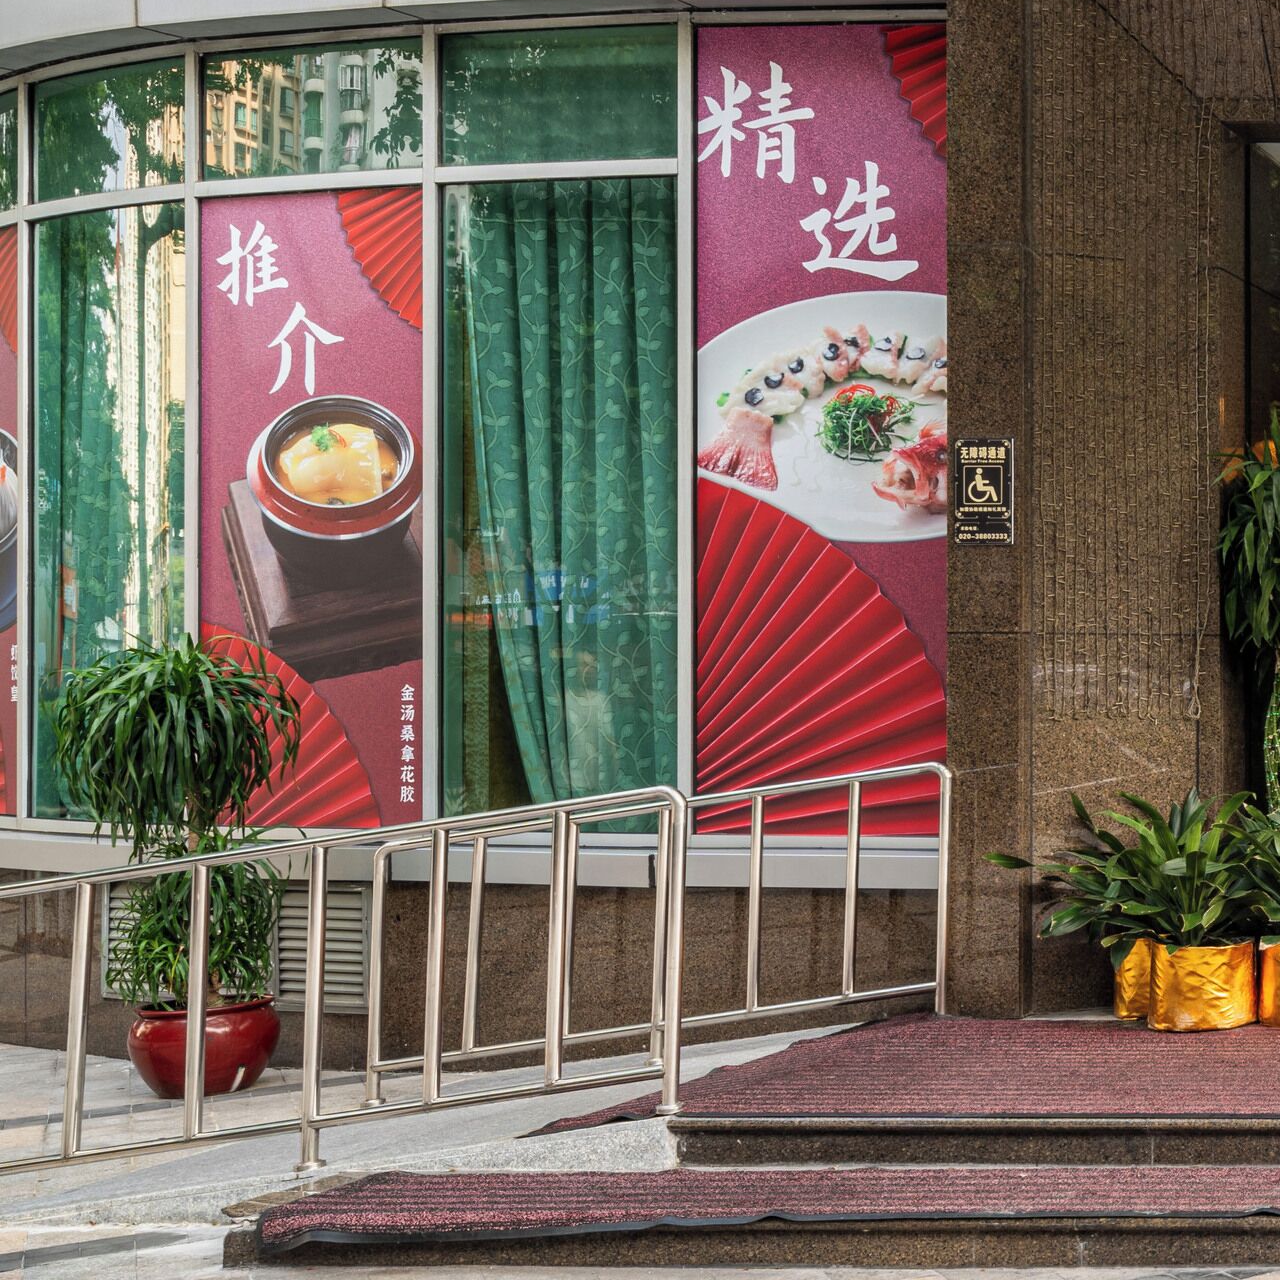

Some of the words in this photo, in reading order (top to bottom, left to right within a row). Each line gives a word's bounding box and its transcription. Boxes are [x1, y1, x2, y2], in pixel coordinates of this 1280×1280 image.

[697, 61, 919, 281] 精选
[216, 219, 345, 396] 推介
[400, 684, 415, 803] 金汤桑拿花胶
